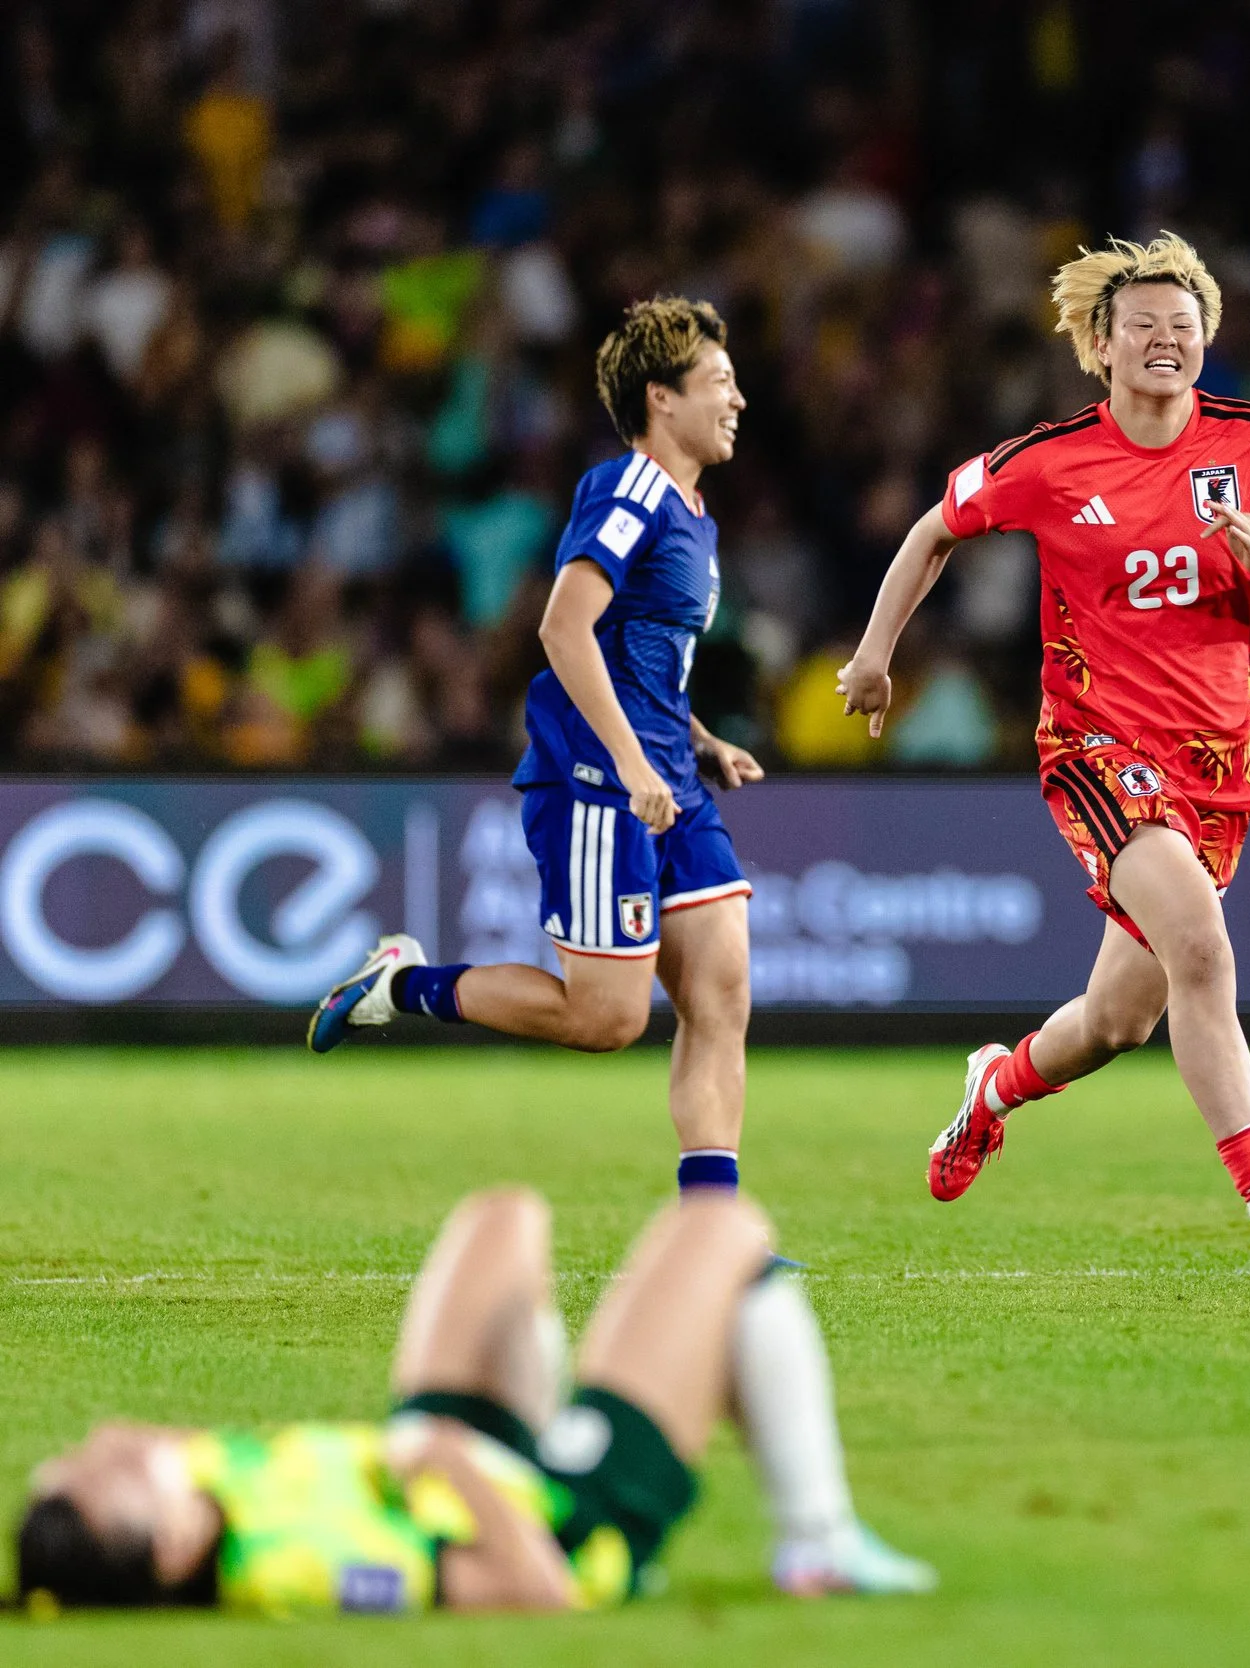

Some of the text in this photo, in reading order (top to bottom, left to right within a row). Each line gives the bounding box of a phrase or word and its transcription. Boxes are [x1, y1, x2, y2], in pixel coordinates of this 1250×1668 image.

[1201, 469, 1226, 477] JAPAN
[1125, 545, 1200, 609] 23
[0, 797, 381, 1004] ce
